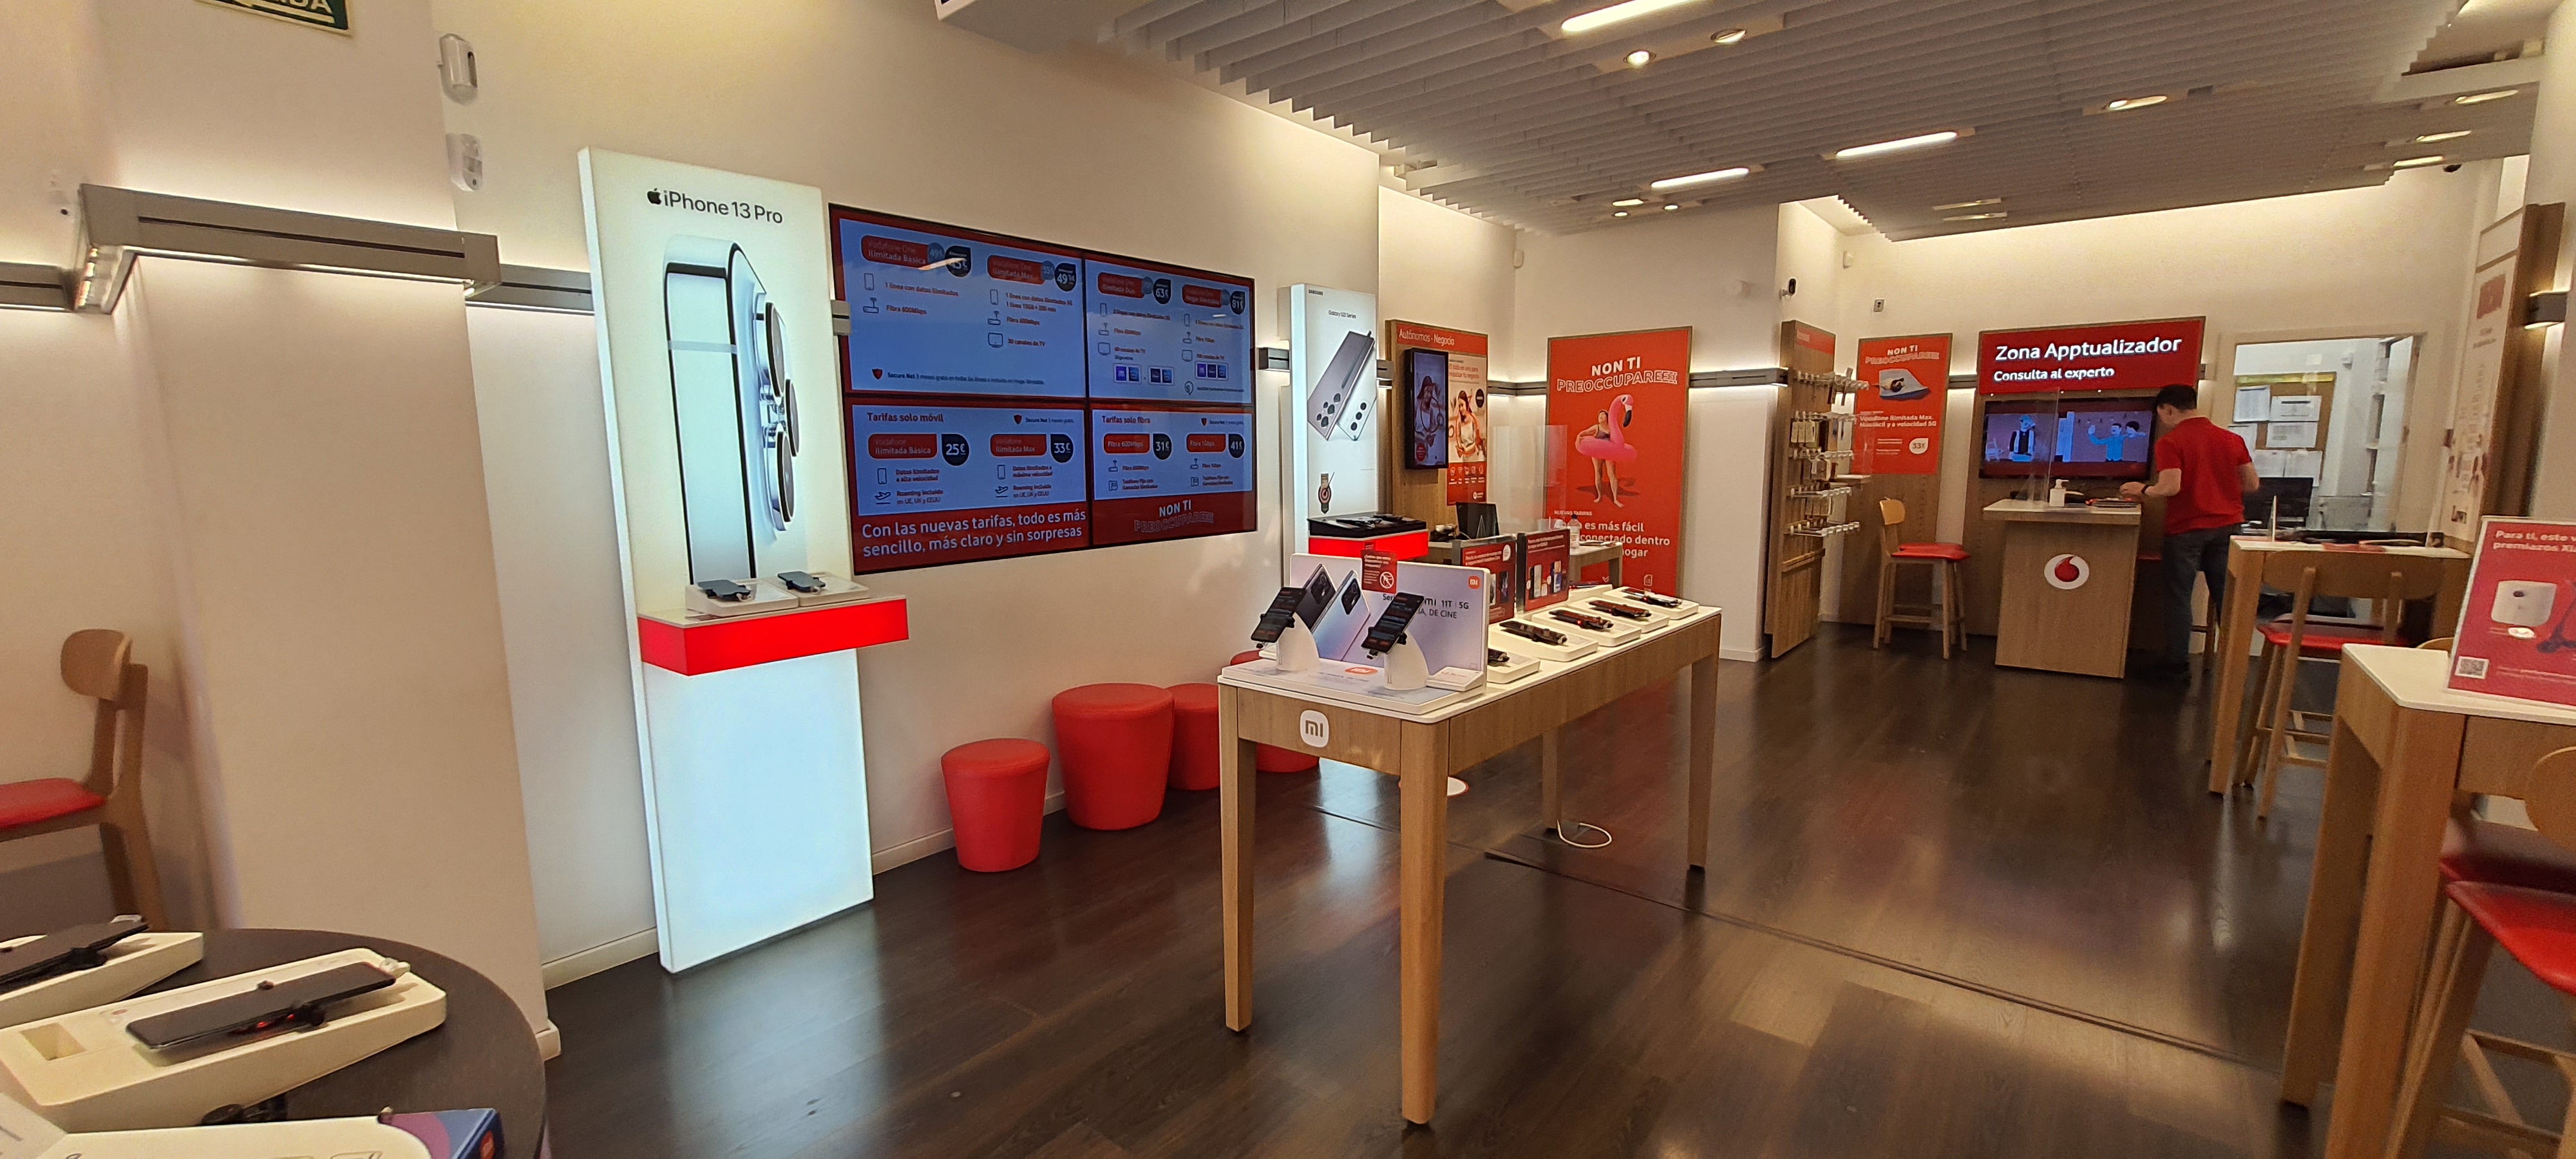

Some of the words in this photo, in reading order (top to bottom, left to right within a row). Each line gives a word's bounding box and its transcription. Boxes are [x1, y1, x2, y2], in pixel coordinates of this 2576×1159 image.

[663, 190, 729, 216] iPhone
[731, 201, 751, 219] 13
[754, 205, 783, 224] Pro
[1399, 328, 1430, 342] Autónomos
[1434, 334, 1455, 346] Negocio
[1887, 346, 1907, 355] NON
[1995, 345, 2040, 361] Zona
[2044, 337, 2183, 361] Apptualizador
[1591, 359, 1623, 377] NON
[1626, 356, 1641, 370] TI
[1994, 370, 2047, 382] Consulta
[2050, 368, 2062, 379] al
[2065, 366, 2115, 380] experto
[867, 412, 898, 422] Tarifas
[900, 413, 918, 422] solo
[920, 413, 943, 422] móvil
[875, 446, 907, 455] Ilimitada
[909, 446, 931, 455] Básica
[945, 443, 966, 456] 25€
[1054, 442, 1071, 453] 33€
[1155, 441, 1170, 451] 31€
[1230, 440, 1243, 451] 41€
[1159, 502, 1180, 517] NON
[1182, 500, 1191, 511] TI
[862, 523, 891, 538] Con
[895, 521, 916, 536] las
[920, 519, 969, 533] nuevas
[972, 513, 1015, 529] tarifas,
[1018, 511, 1045, 526] todo
[1048, 513, 1061, 523] es
[1063, 509, 1086, 521] más
[1598, 521, 1620, 531] más
[1622, 522, 1644, 532] fácil
[1634, 534, 1670, 545] dentro
[2496, 530, 2523, 539] Para
[863, 539, 925, 557] sencillo,
[929, 536, 958, 551] más
[961, 533, 994, 548] claro
[996, 534, 1003, 547] y
[1007, 530, 1024, 543] sin
[1027, 525, 1082, 542] sorpresas
[1622, 548, 1648, 558] ogar
[1441, 610, 1457, 619] CINE
